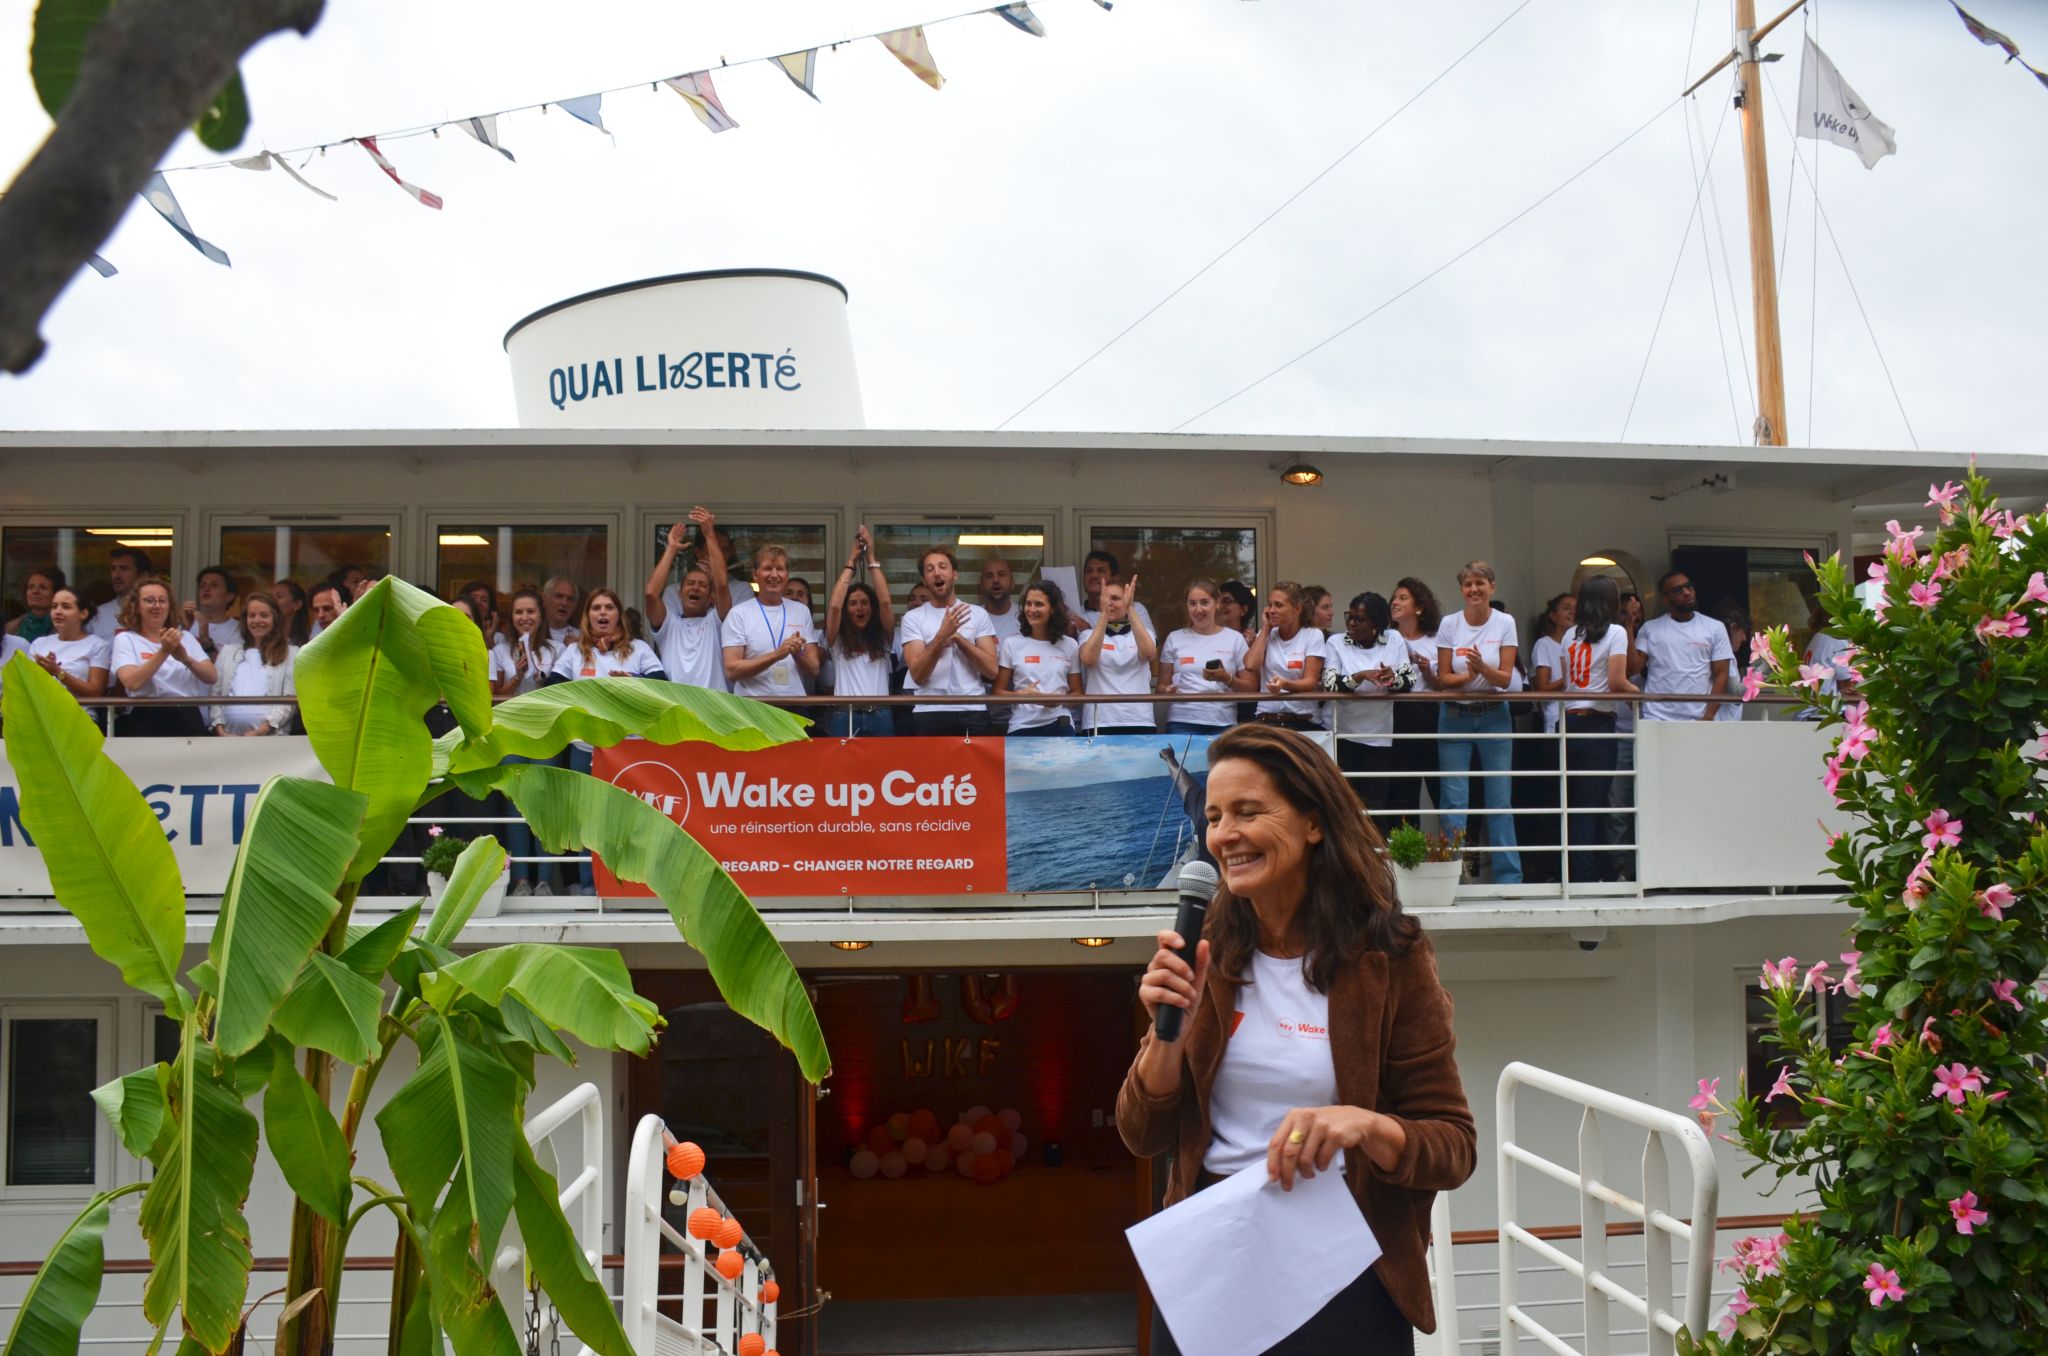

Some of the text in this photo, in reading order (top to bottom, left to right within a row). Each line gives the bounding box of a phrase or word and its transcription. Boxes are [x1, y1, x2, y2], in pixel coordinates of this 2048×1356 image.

[549, 347, 802, 411] QUAI LIBERTÉ
[1568, 641, 1592, 689] 10
[622, 788, 683, 815] KF
[696, 769, 977, 817] Wake up Café
[710, 819, 971, 834] une réinsertion durable, sans récidive
[721, 860, 780, 872] REGARD
[793, 859, 863, 871] CHANGER
[866, 859, 913, 870] NOTRE
[916, 858, 974, 870] REGARD
[1298, 1023, 1326, 1034] Wake
[900, 1036, 1001, 1080] WKF
